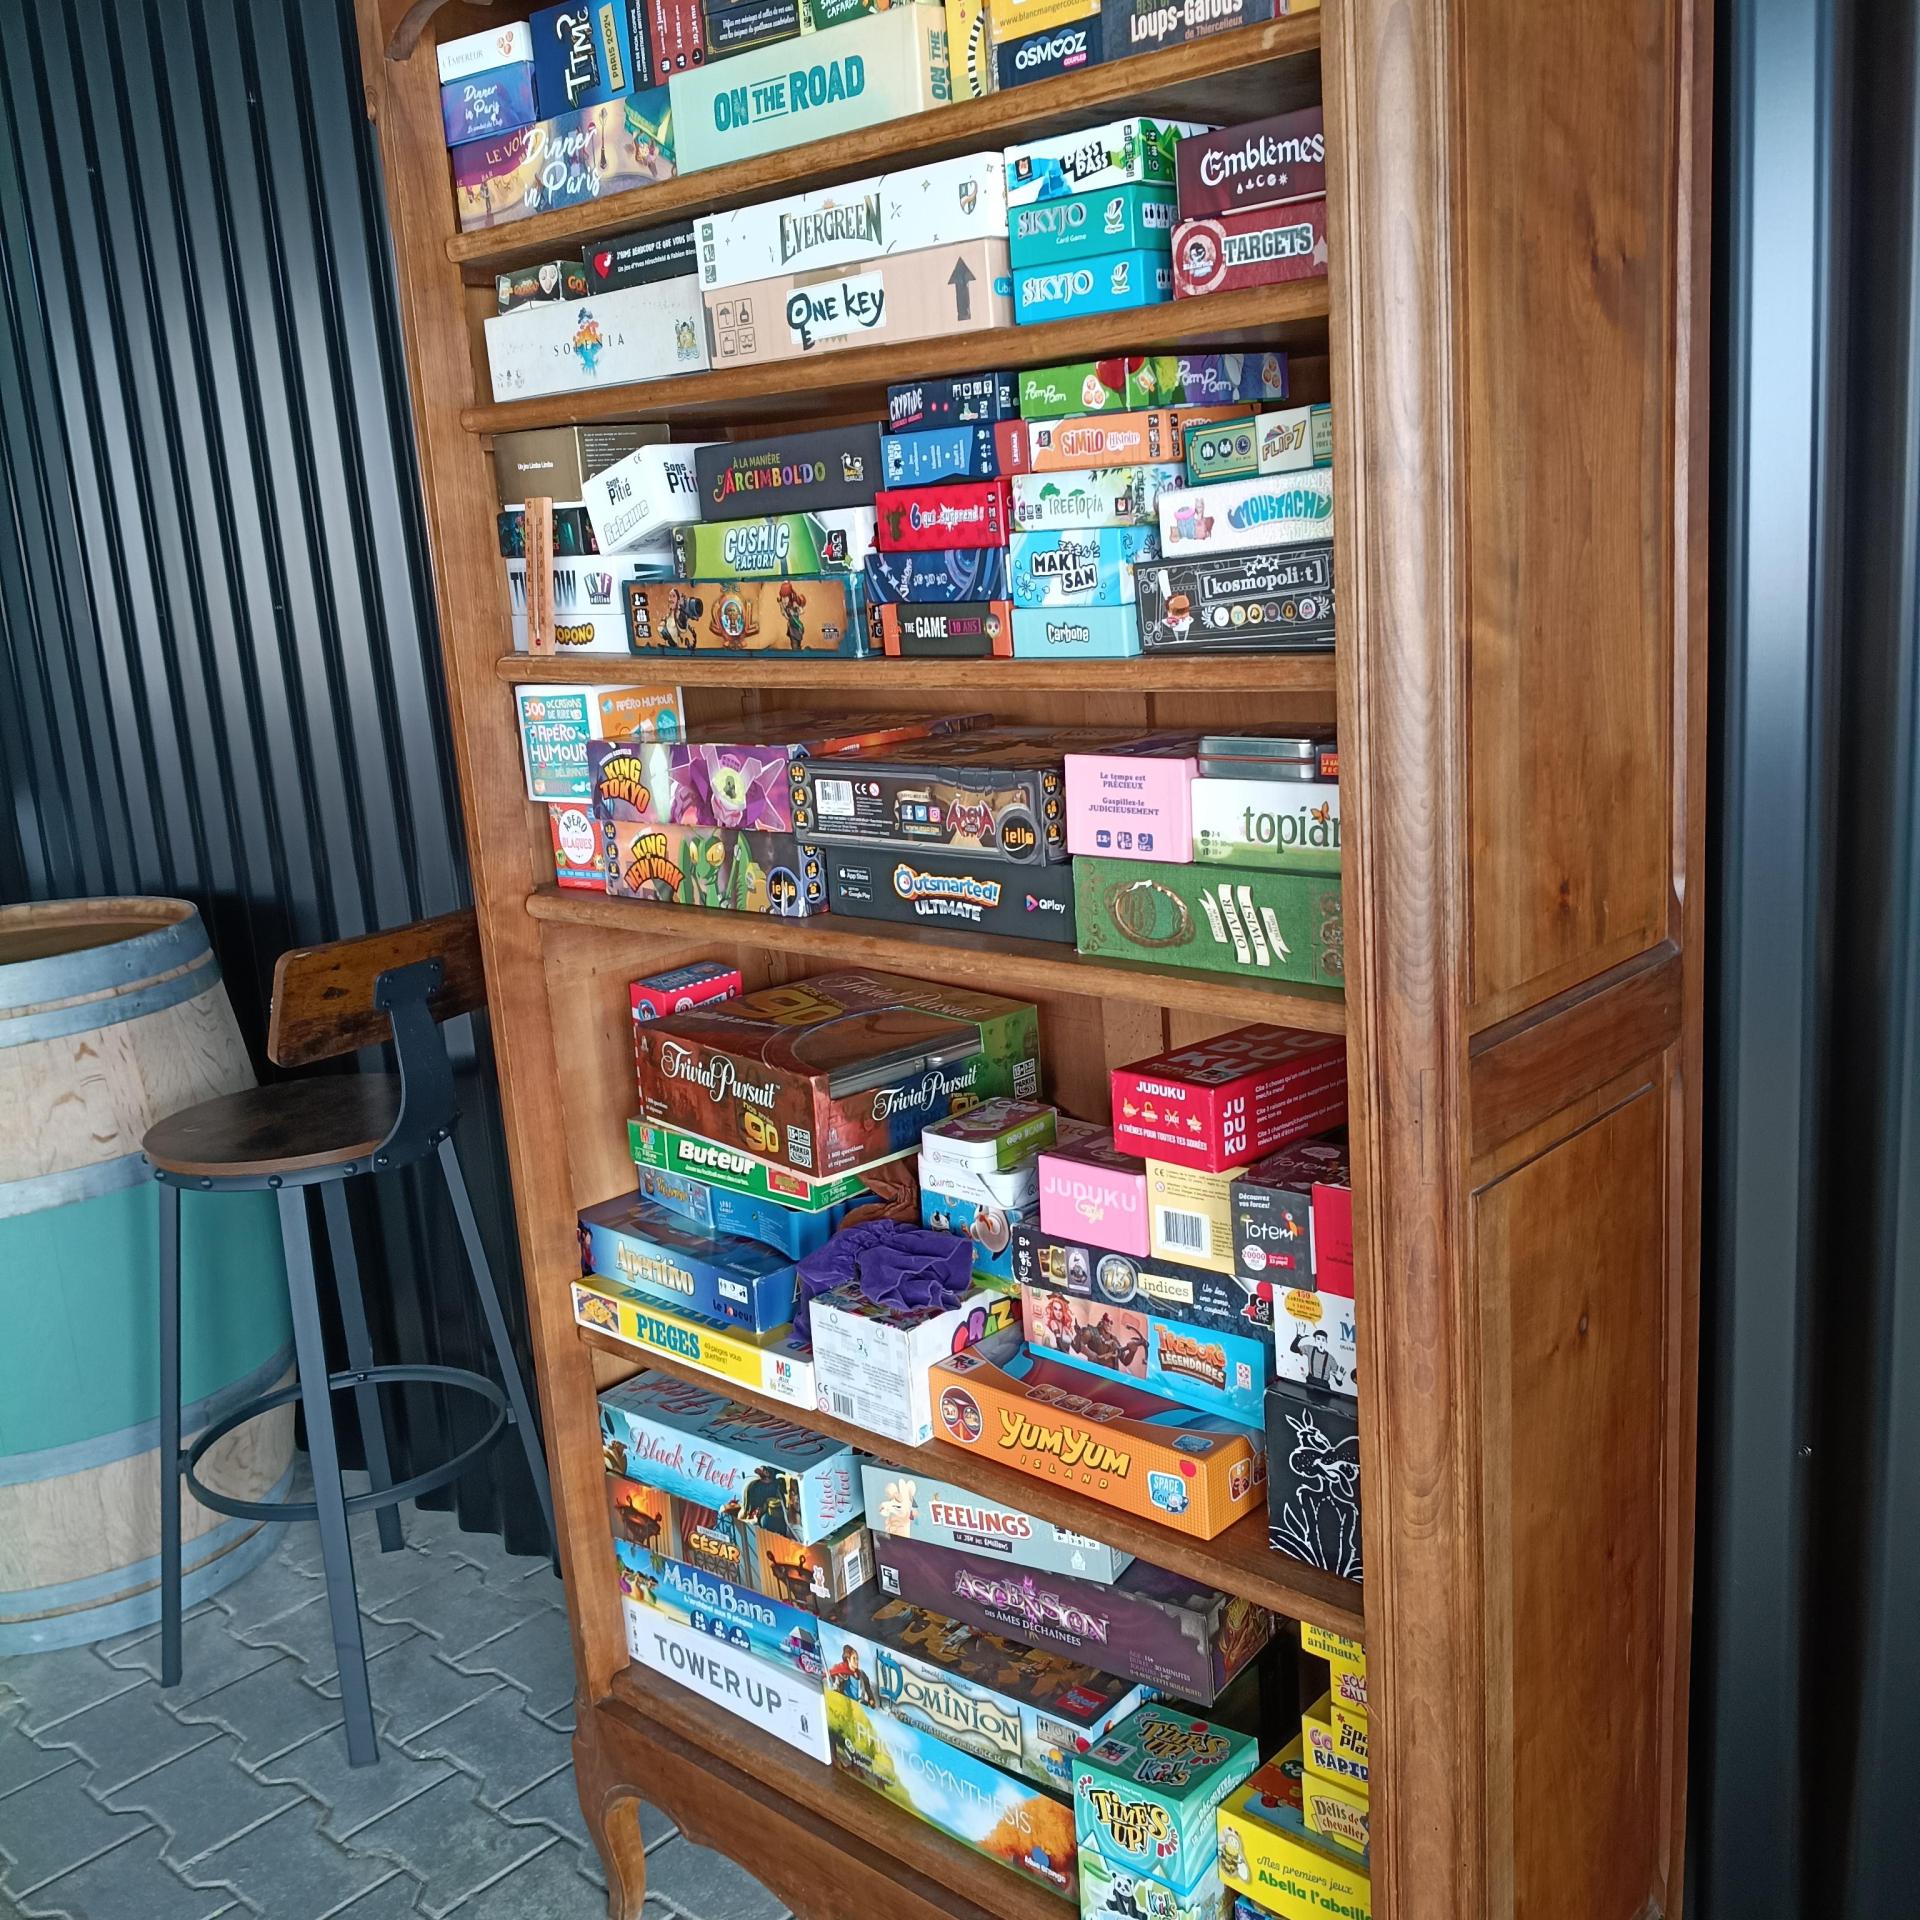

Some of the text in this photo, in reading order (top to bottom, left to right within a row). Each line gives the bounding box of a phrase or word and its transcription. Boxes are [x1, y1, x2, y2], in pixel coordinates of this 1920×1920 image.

[603, 14, 620, 78] PARIS 2024
[930, 30, 946, 100] ON THE
[463, 85, 498, 103] Dinner
[714, 55, 865, 132] ON THE ROAD
[465, 100, 501, 120] in Paris
[522, 128, 597, 165] Dinner
[1064, 142, 1101, 169] PASS
[1201, 132, 1325, 187] Emblèmes
[1077, 153, 1109, 177] PASS
[524, 161, 601, 208] in Paris
[779, 192, 882, 266] EVERGREEN
[1018, 202, 1087, 239] SKYJO
[1056, 234, 1087, 244] Card Game
[1223, 226, 1312, 262] TARGETS
[1022, 269, 1094, 307] SKYJO
[1262, 420, 1307, 462] FLIP 7
[740, 457, 748, 468] LA
[749, 452, 781, 468] MANIÈRE
[608, 478, 632, 506] Pitié
[666, 471, 698, 494] Piti
[910, 503, 921, 529] 6
[724, 523, 790, 564] COSMIC
[735, 553, 777, 572] FACTORY
[1034, 553, 1078, 573] MAKI
[1064, 568, 1096, 589] SAN
[904, 622, 915, 634] THE
[916, 617, 948, 639] GAME
[1048, 622, 1090, 643] Carbone
[523, 701, 546, 718] 300
[604, 757, 642, 783] KING
[1110, 773, 1133, 783] temps
[600, 777, 651, 814] TOKYO
[1088, 804, 1160, 816] JUDICIEUSEMENT
[631, 833, 668, 857] KING
[624, 858, 651, 893] NEW
[651, 855, 685, 892] YORK
[915, 900, 983, 922] ULTIMATE
[661, 1041, 777, 1110] Trivial Pursuit
[1136, 1081, 1186, 1101] JUDUKU
[872, 1064, 977, 1121] Trivial Pursuit
[1222, 1097, 1245, 1118] JU
[744, 1111, 779, 1153] 90
[1223, 1116, 1246, 1137] DU
[679, 1139, 756, 1175] Buteur
[1224, 1135, 1247, 1156] KU
[1044, 1176, 1137, 1212] JUDUKU
[1243, 1218, 1294, 1241] Totem
[614, 1240, 695, 1296] Aperitivo
[1143, 1276, 1190, 1297] indices
[635, 1311, 701, 1360] PIEGES
[776, 1360, 791, 1379] MB
[629, 1427, 738, 1490] Black Fleet
[1020, 1455, 1109, 1489] ISLAND
[1153, 1475, 1180, 1491] SPACE
[930, 1502, 1031, 1538] FEELINGS
[689, 1532, 741, 1564] CÉSAR
[663, 1561, 719, 1607] Maka
[719, 1583, 777, 1628] Bana
[952, 1568, 1110, 1646] ASCENSION
[1307, 1636, 1361, 1664] animaux
[653, 1632, 782, 1714] TOWER UP
[856, 1721, 1033, 1834] PHOTOSYNTHESIS
[1314, 1748, 1369, 1781] RAPID
[1110, 1820, 1150, 1854] UP!
[1321, 1815, 1365, 1842] chevalier
[1257, 1855, 1354, 1896] Mes premiers jeux
[1258, 1868, 1306, 1900] Abella
